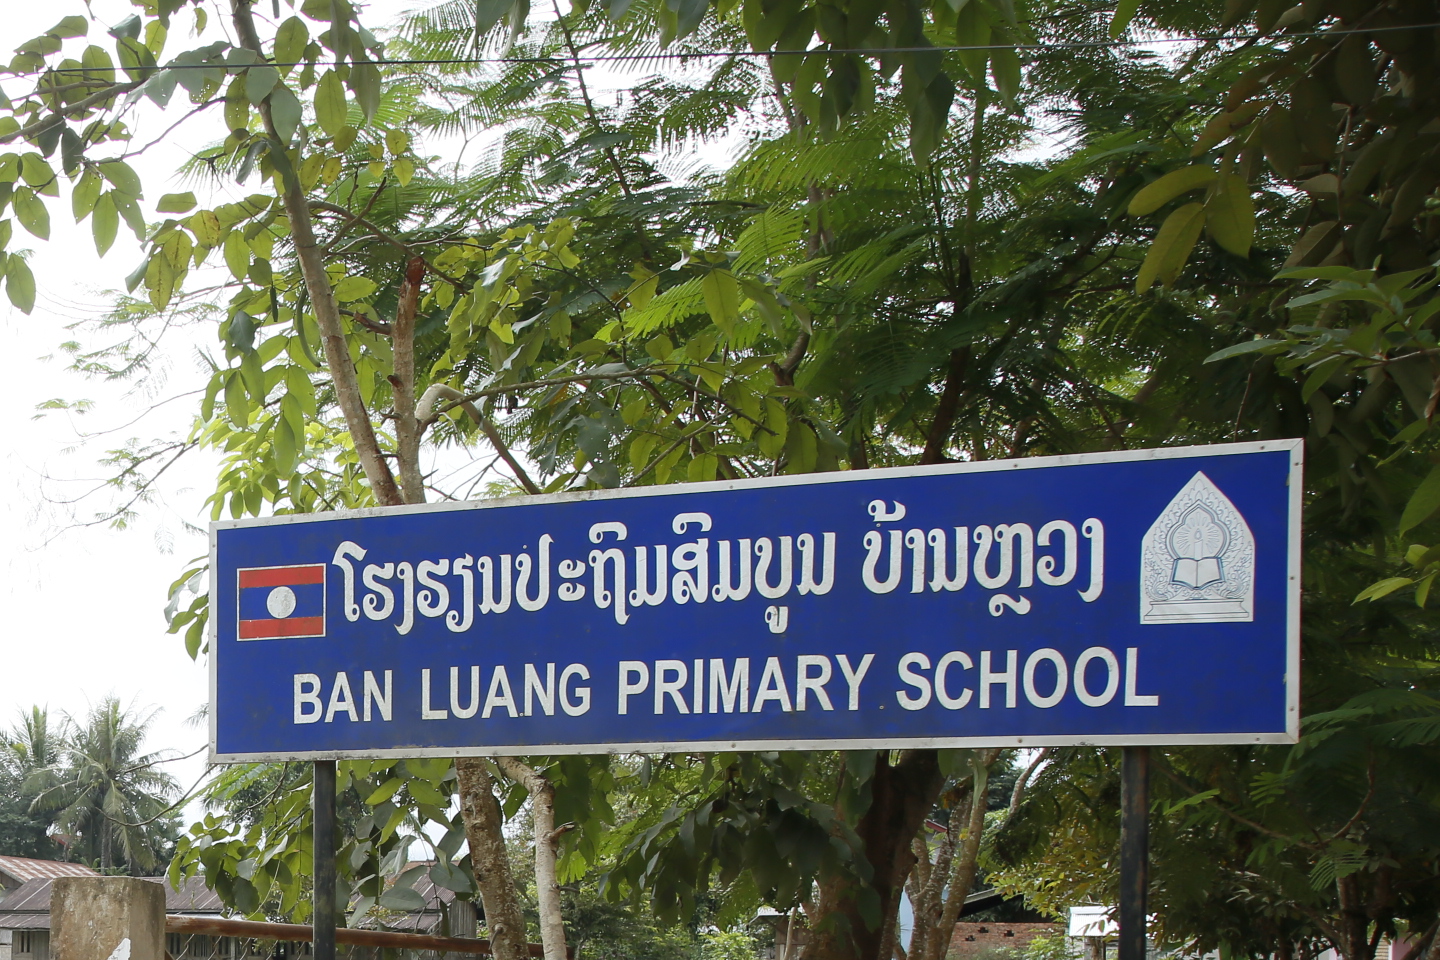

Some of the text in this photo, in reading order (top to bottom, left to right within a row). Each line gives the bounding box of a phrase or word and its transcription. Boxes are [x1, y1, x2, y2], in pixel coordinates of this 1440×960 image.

[332, 499, 1104, 636] ໂຮງຮຽນປະຖົມສົມບູນ ບ້ານຫຼວງ
[293, 646, 1159, 725] BAN LUANG PRIMARY SCHOOL
